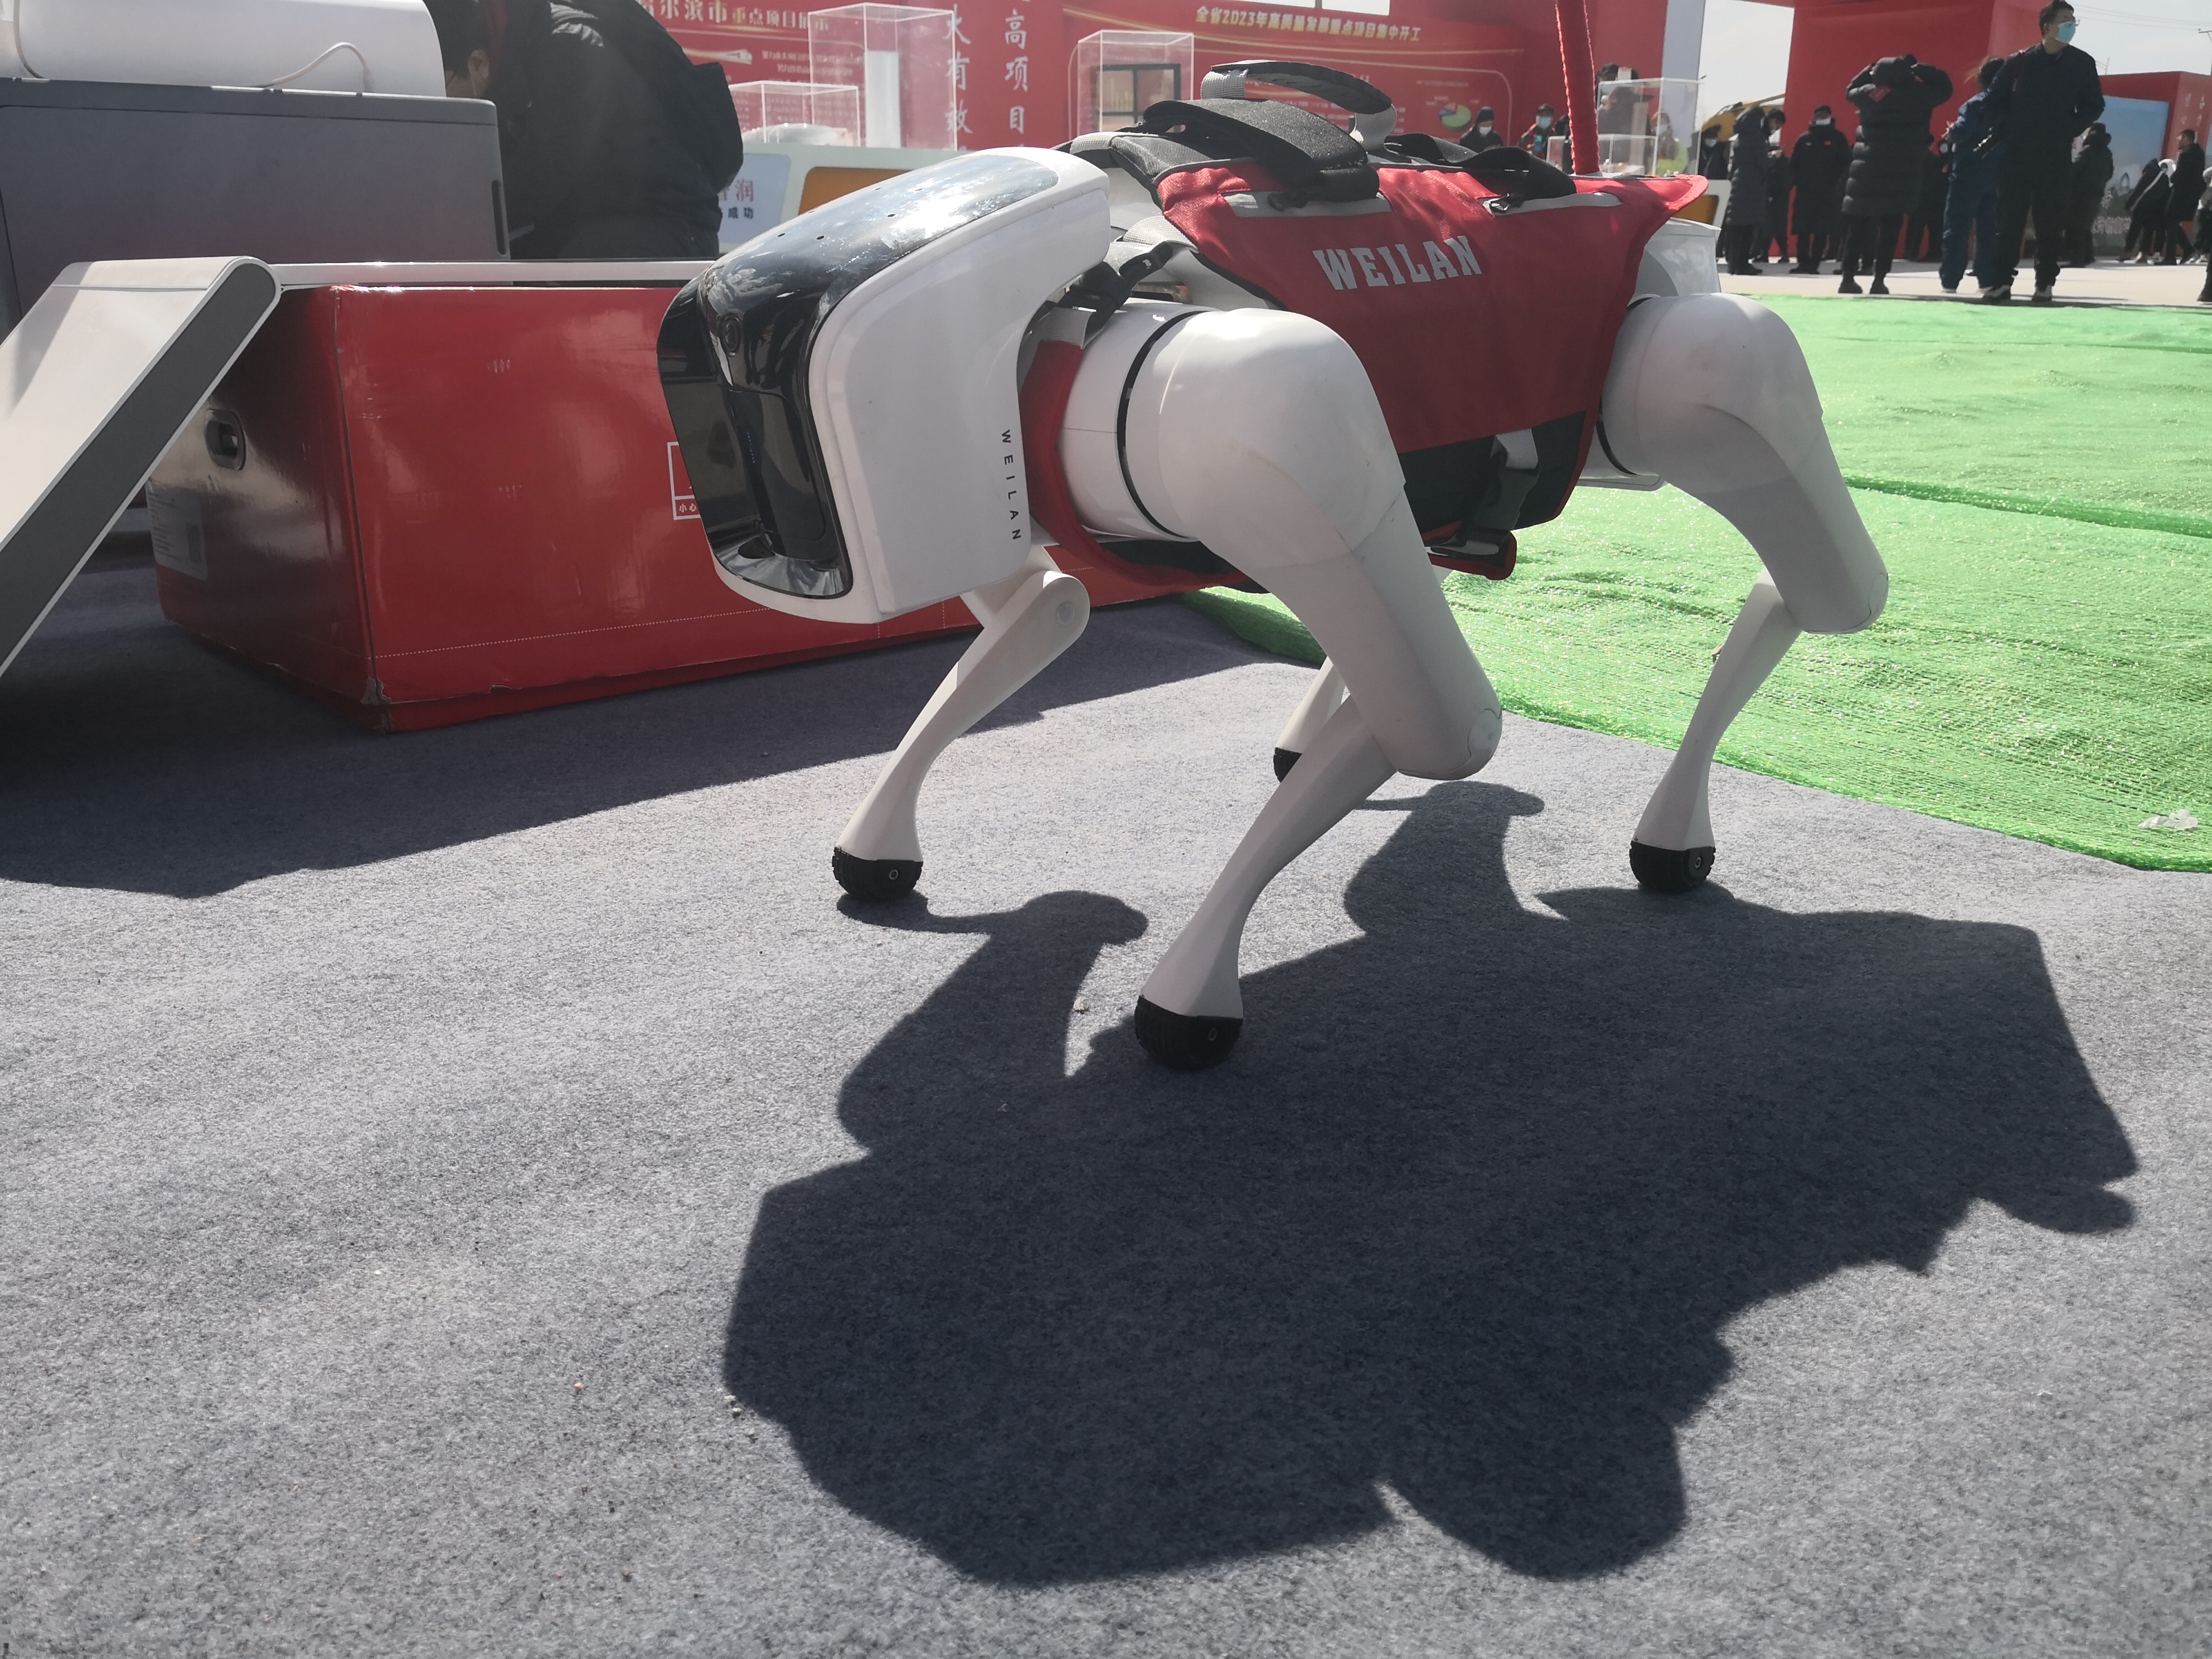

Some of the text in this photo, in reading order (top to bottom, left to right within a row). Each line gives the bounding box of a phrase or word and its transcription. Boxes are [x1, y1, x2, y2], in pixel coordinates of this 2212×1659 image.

[942, 3, 973, 151] 大有效
[1004, 0, 1029, 147] 高项目
[1312, 235, 1482, 290] WEILAN
[679, 503, 697, 513] 小心
[1001, 429, 1022, 540] WEILAN
